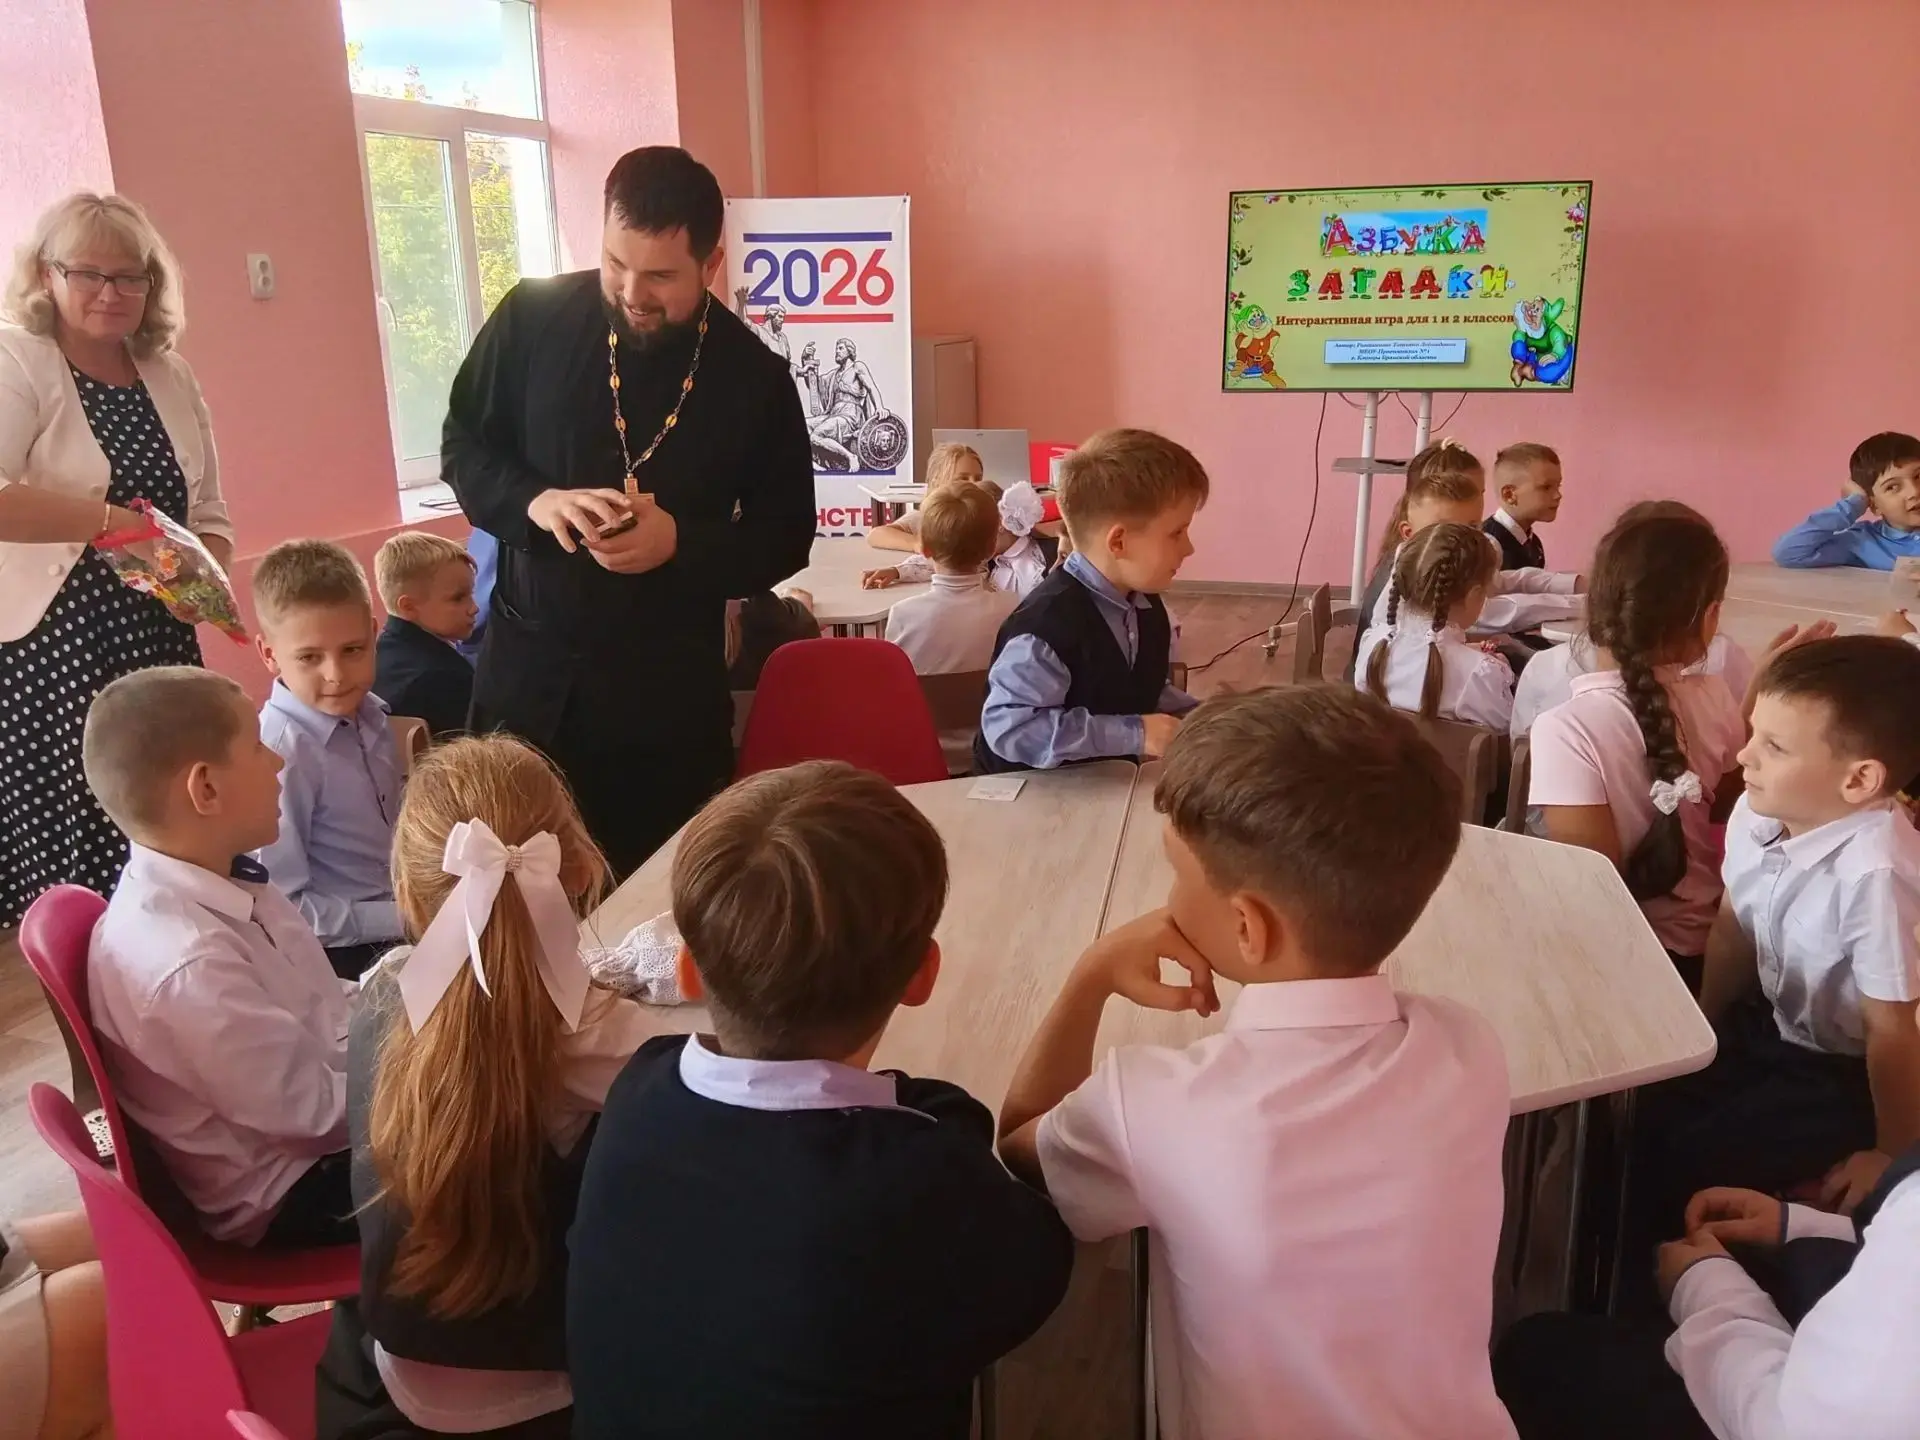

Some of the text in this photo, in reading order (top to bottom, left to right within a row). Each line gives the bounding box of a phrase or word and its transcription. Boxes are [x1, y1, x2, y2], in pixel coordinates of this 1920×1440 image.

[743, 248, 894, 306] 2026
[1286, 264, 1514, 302] ЗАГАДКИ
[1276, 314, 1514, 327] Интерактивная игра для 1 и 2 классов
